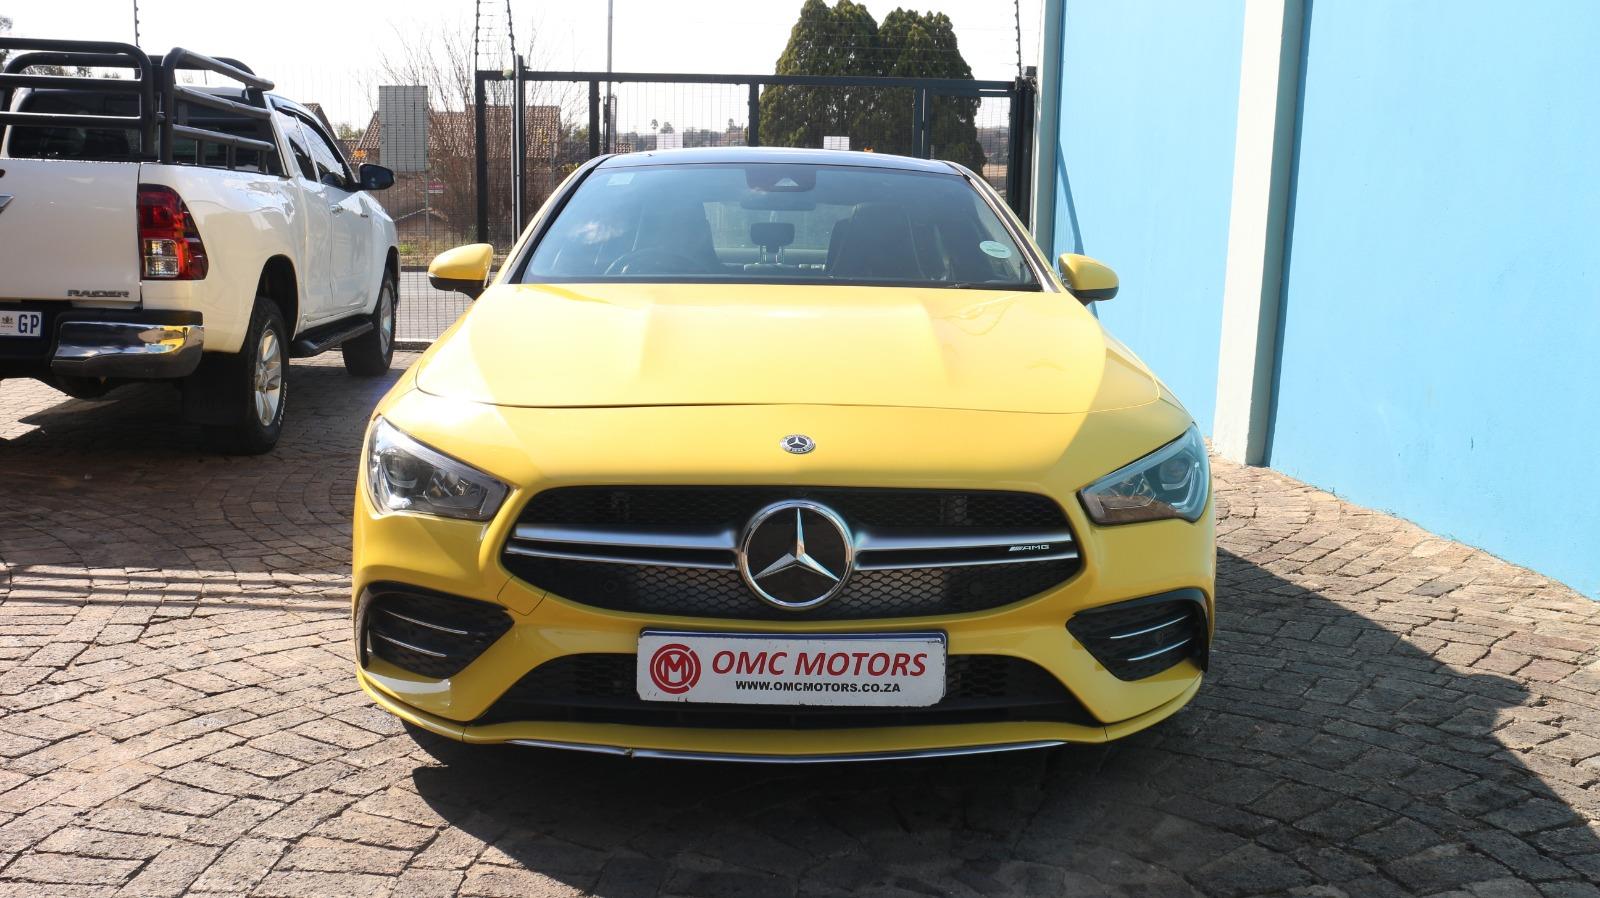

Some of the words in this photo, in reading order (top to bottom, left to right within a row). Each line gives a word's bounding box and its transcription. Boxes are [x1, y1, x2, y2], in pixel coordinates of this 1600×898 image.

[67, 289, 130, 298] RAIDER
[18, 314, 40, 334] GP
[712, 650, 788, 676] OMC
[794, 652, 928, 677] MOTORS
[735, 680, 901, 693] WWW.OMCMOTORS.CO.ZA
